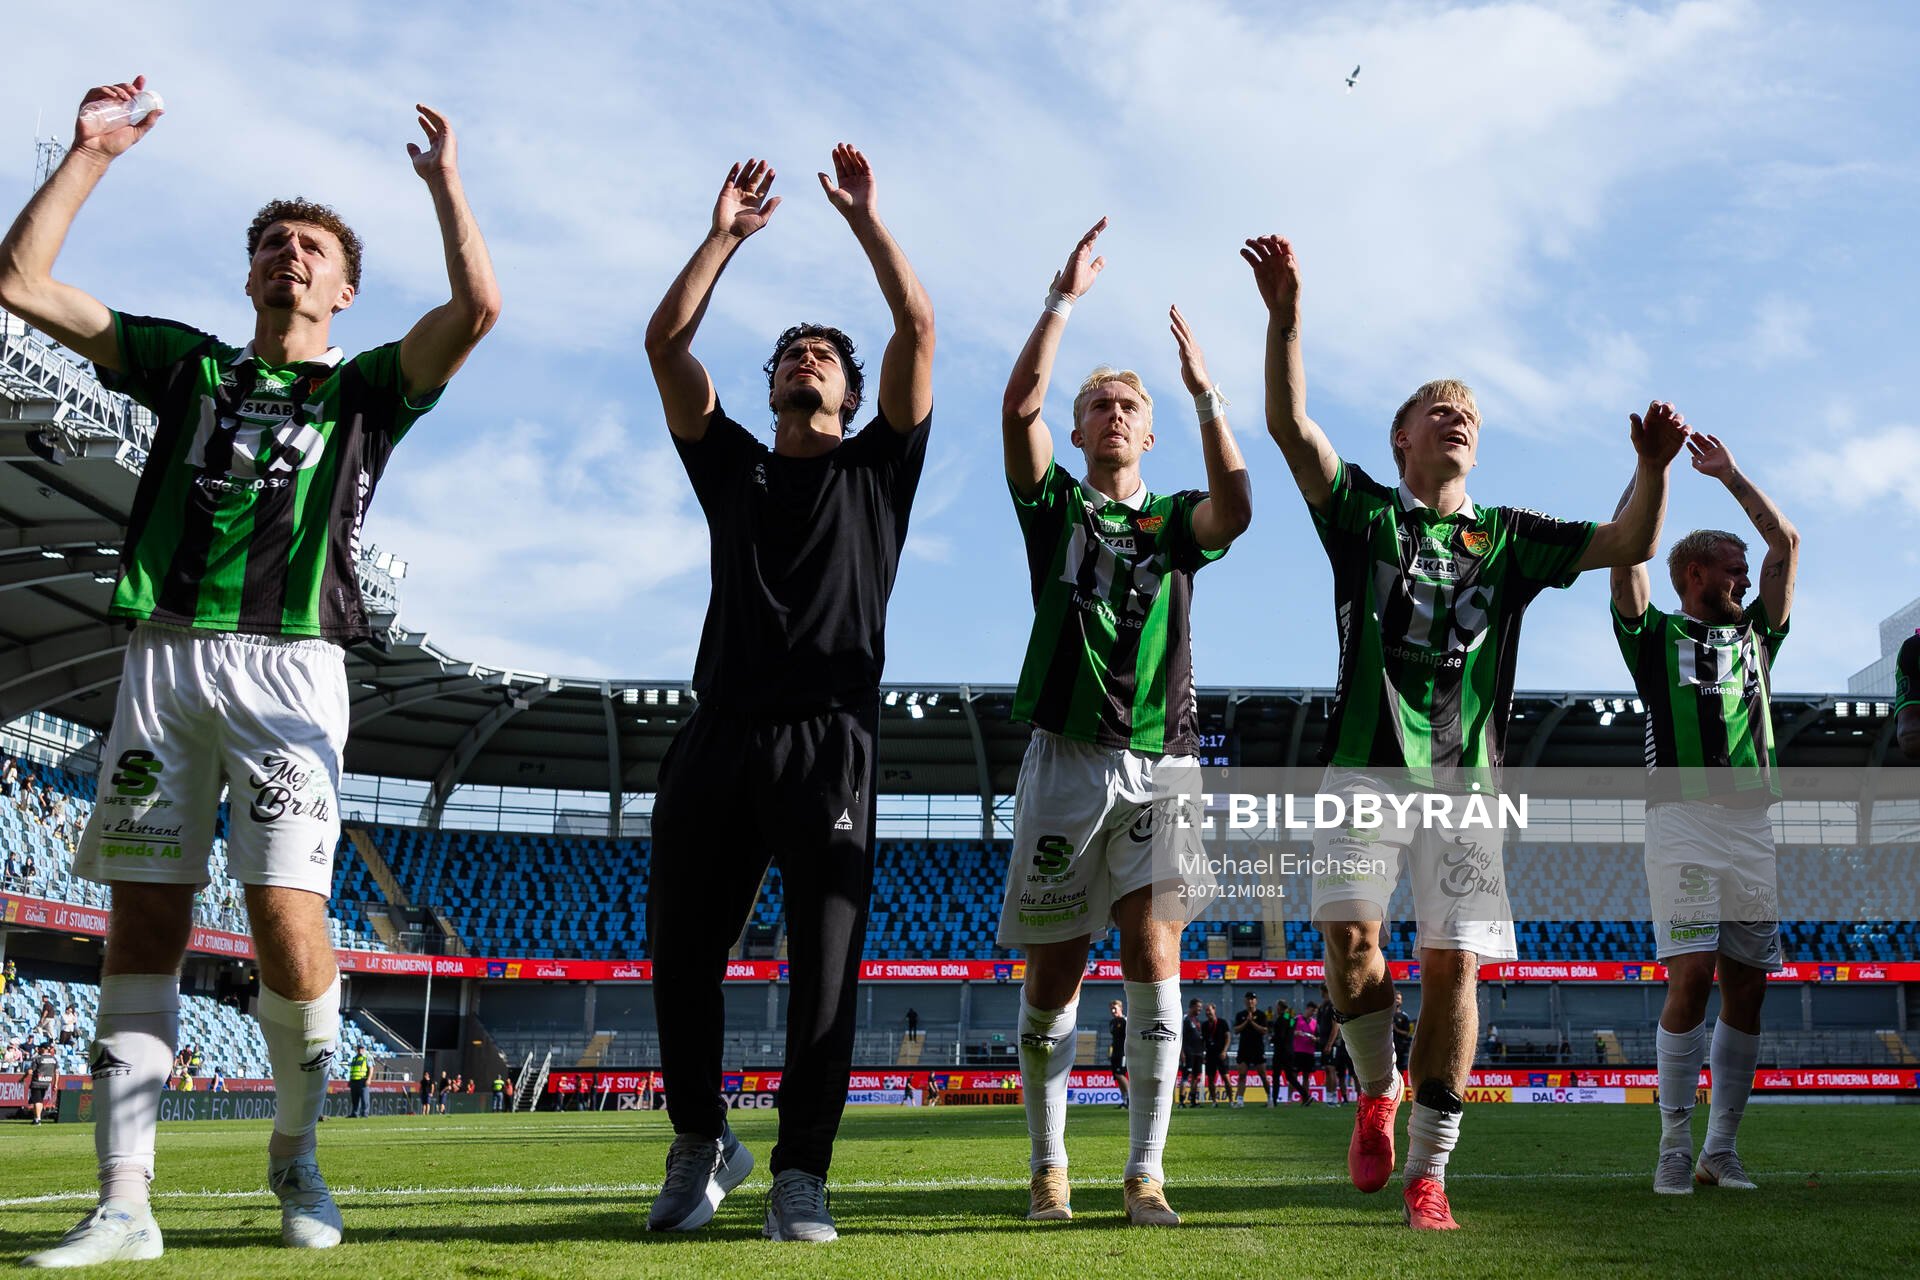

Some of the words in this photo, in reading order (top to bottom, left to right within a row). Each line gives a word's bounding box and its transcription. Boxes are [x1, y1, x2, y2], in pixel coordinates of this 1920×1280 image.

[243, 402, 294, 416] SKAB
[1103, 537, 1134, 549] KAB
[1414, 557, 1456, 573] SKAB
[1384, 645, 1462, 669] ndeship.se
[250, 756, 314, 791] Maj
[115, 819, 181, 838] Ekstrand
[1443, 835, 1496, 870] Maj
[54, 907, 68, 927] LÅT
[69, 911, 107, 932] STUNDERNA
[366, 954, 380, 970] LÅT
[381, 957, 433, 972] STUNDERNA
[436, 959, 464, 974] BÖRJA
[726, 963, 755, 977] BÖRJA
[866, 963, 882, 977] LÅT
[886, 964, 938, 977] STUNDERNA
[940, 963, 969, 977] BÖRJA
[1099, 965, 1123, 977] STUN
[1287, 964, 1303, 977] LÅT
[1306, 965, 1325, 977] STU
[1499, 964, 1515, 977] LÅT
[1518, 966, 1568, 977] STUNDERNA
[1571, 965, 1598, 978] BÖRJA
[1087, 1075, 1116, 1087] BÖRJA
[1484, 1073, 1513, 1086] BÖRJA
[1604, 1072, 1621, 1086] LÅT
[1624, 1074, 1658, 1086] STUNDE
[1797, 1072, 1814, 1086] LÅT
[1817, 1073, 1869, 1086] STUNDERNA
[1871, 1073, 1900, 1086] BÖRJA
[944, 1093, 989, 1105] GORILLA
[992, 1093, 1019, 1105] GLUE
[1077, 1091, 1120, 1105] gypro
[1462, 1089, 1506, 1103] MAX
[1532, 1089, 1574, 1103] DALOC
[160, 1097, 195, 1121] GAIS
[211, 1097, 230, 1120] FC
[235, 1097, 279, 1120] NORDS
